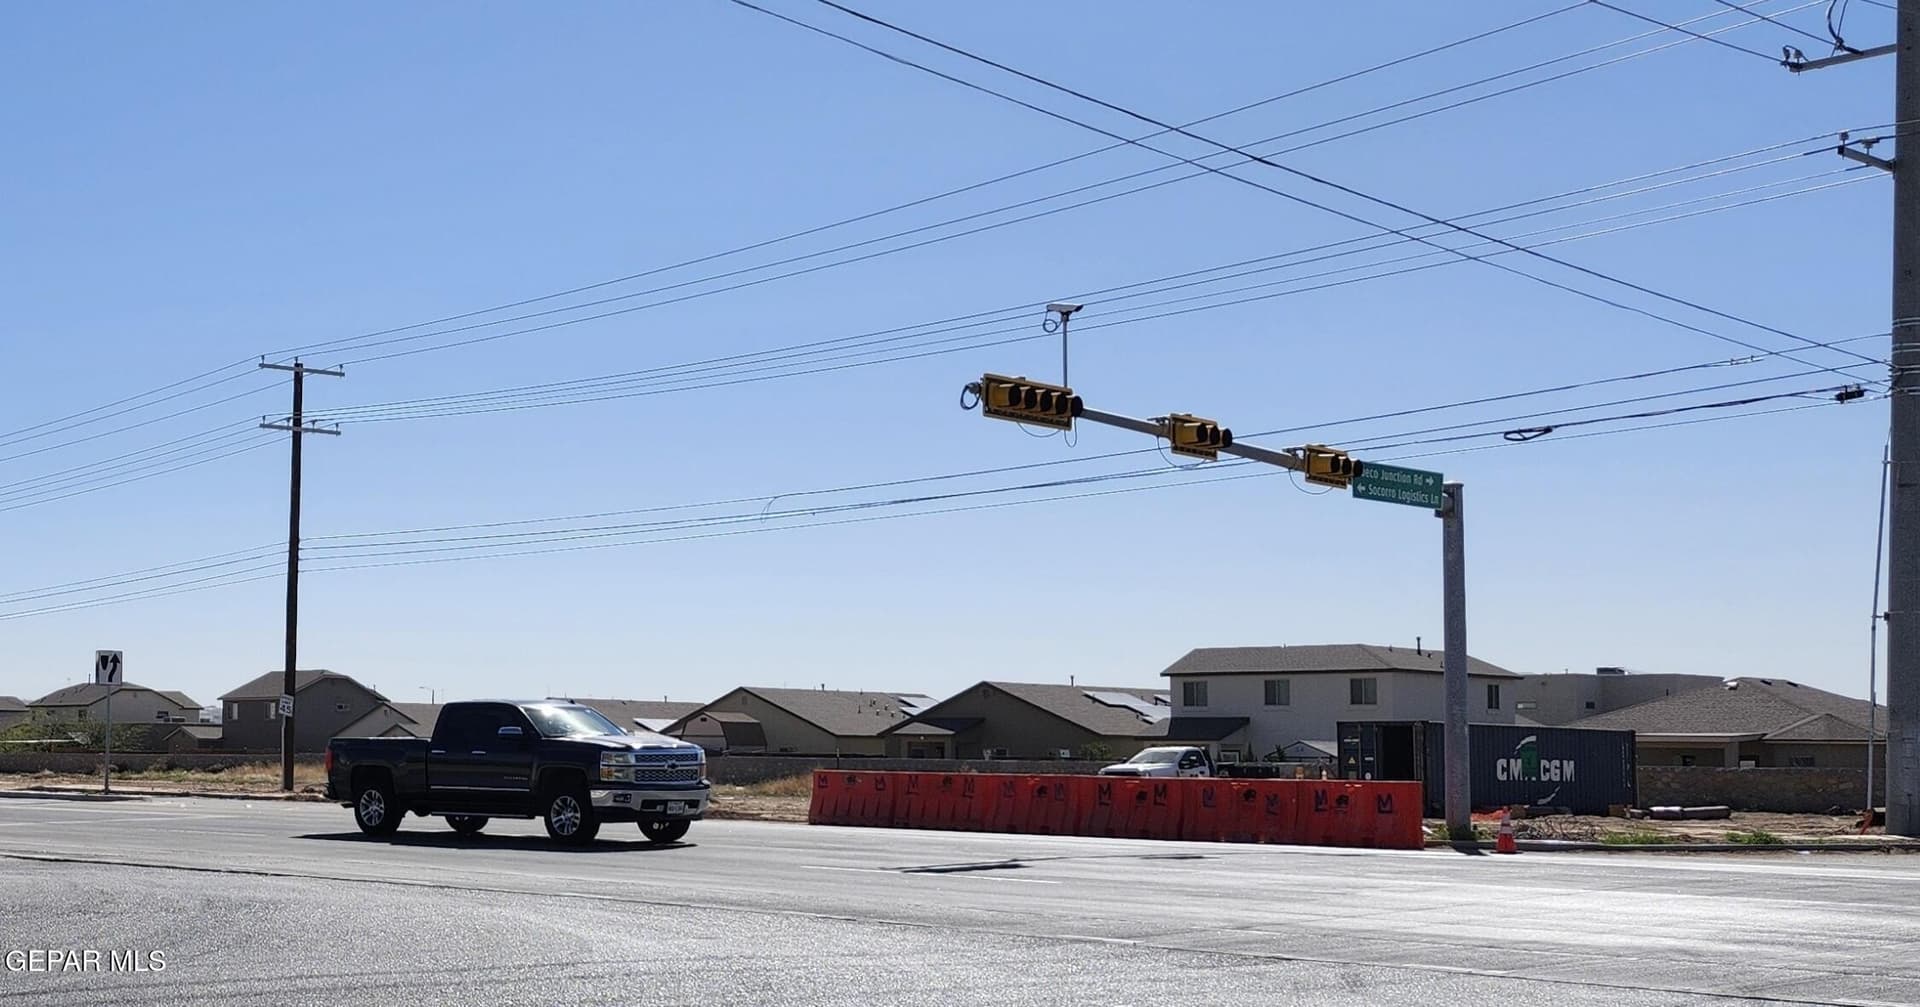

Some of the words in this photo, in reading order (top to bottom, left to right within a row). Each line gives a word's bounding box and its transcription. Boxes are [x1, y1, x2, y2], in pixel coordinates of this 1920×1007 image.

[1381, 469, 1412, 483] Junction
[1413, 474, 1424, 486] Rd
[1368, 483, 1397, 498] Socorro
[1398, 488, 1429, 503] Logistics
[1430, 493, 1440, 504] Ln
[1496, 758, 1536, 781] CM
[1540, 759, 1575, 782] CGM
